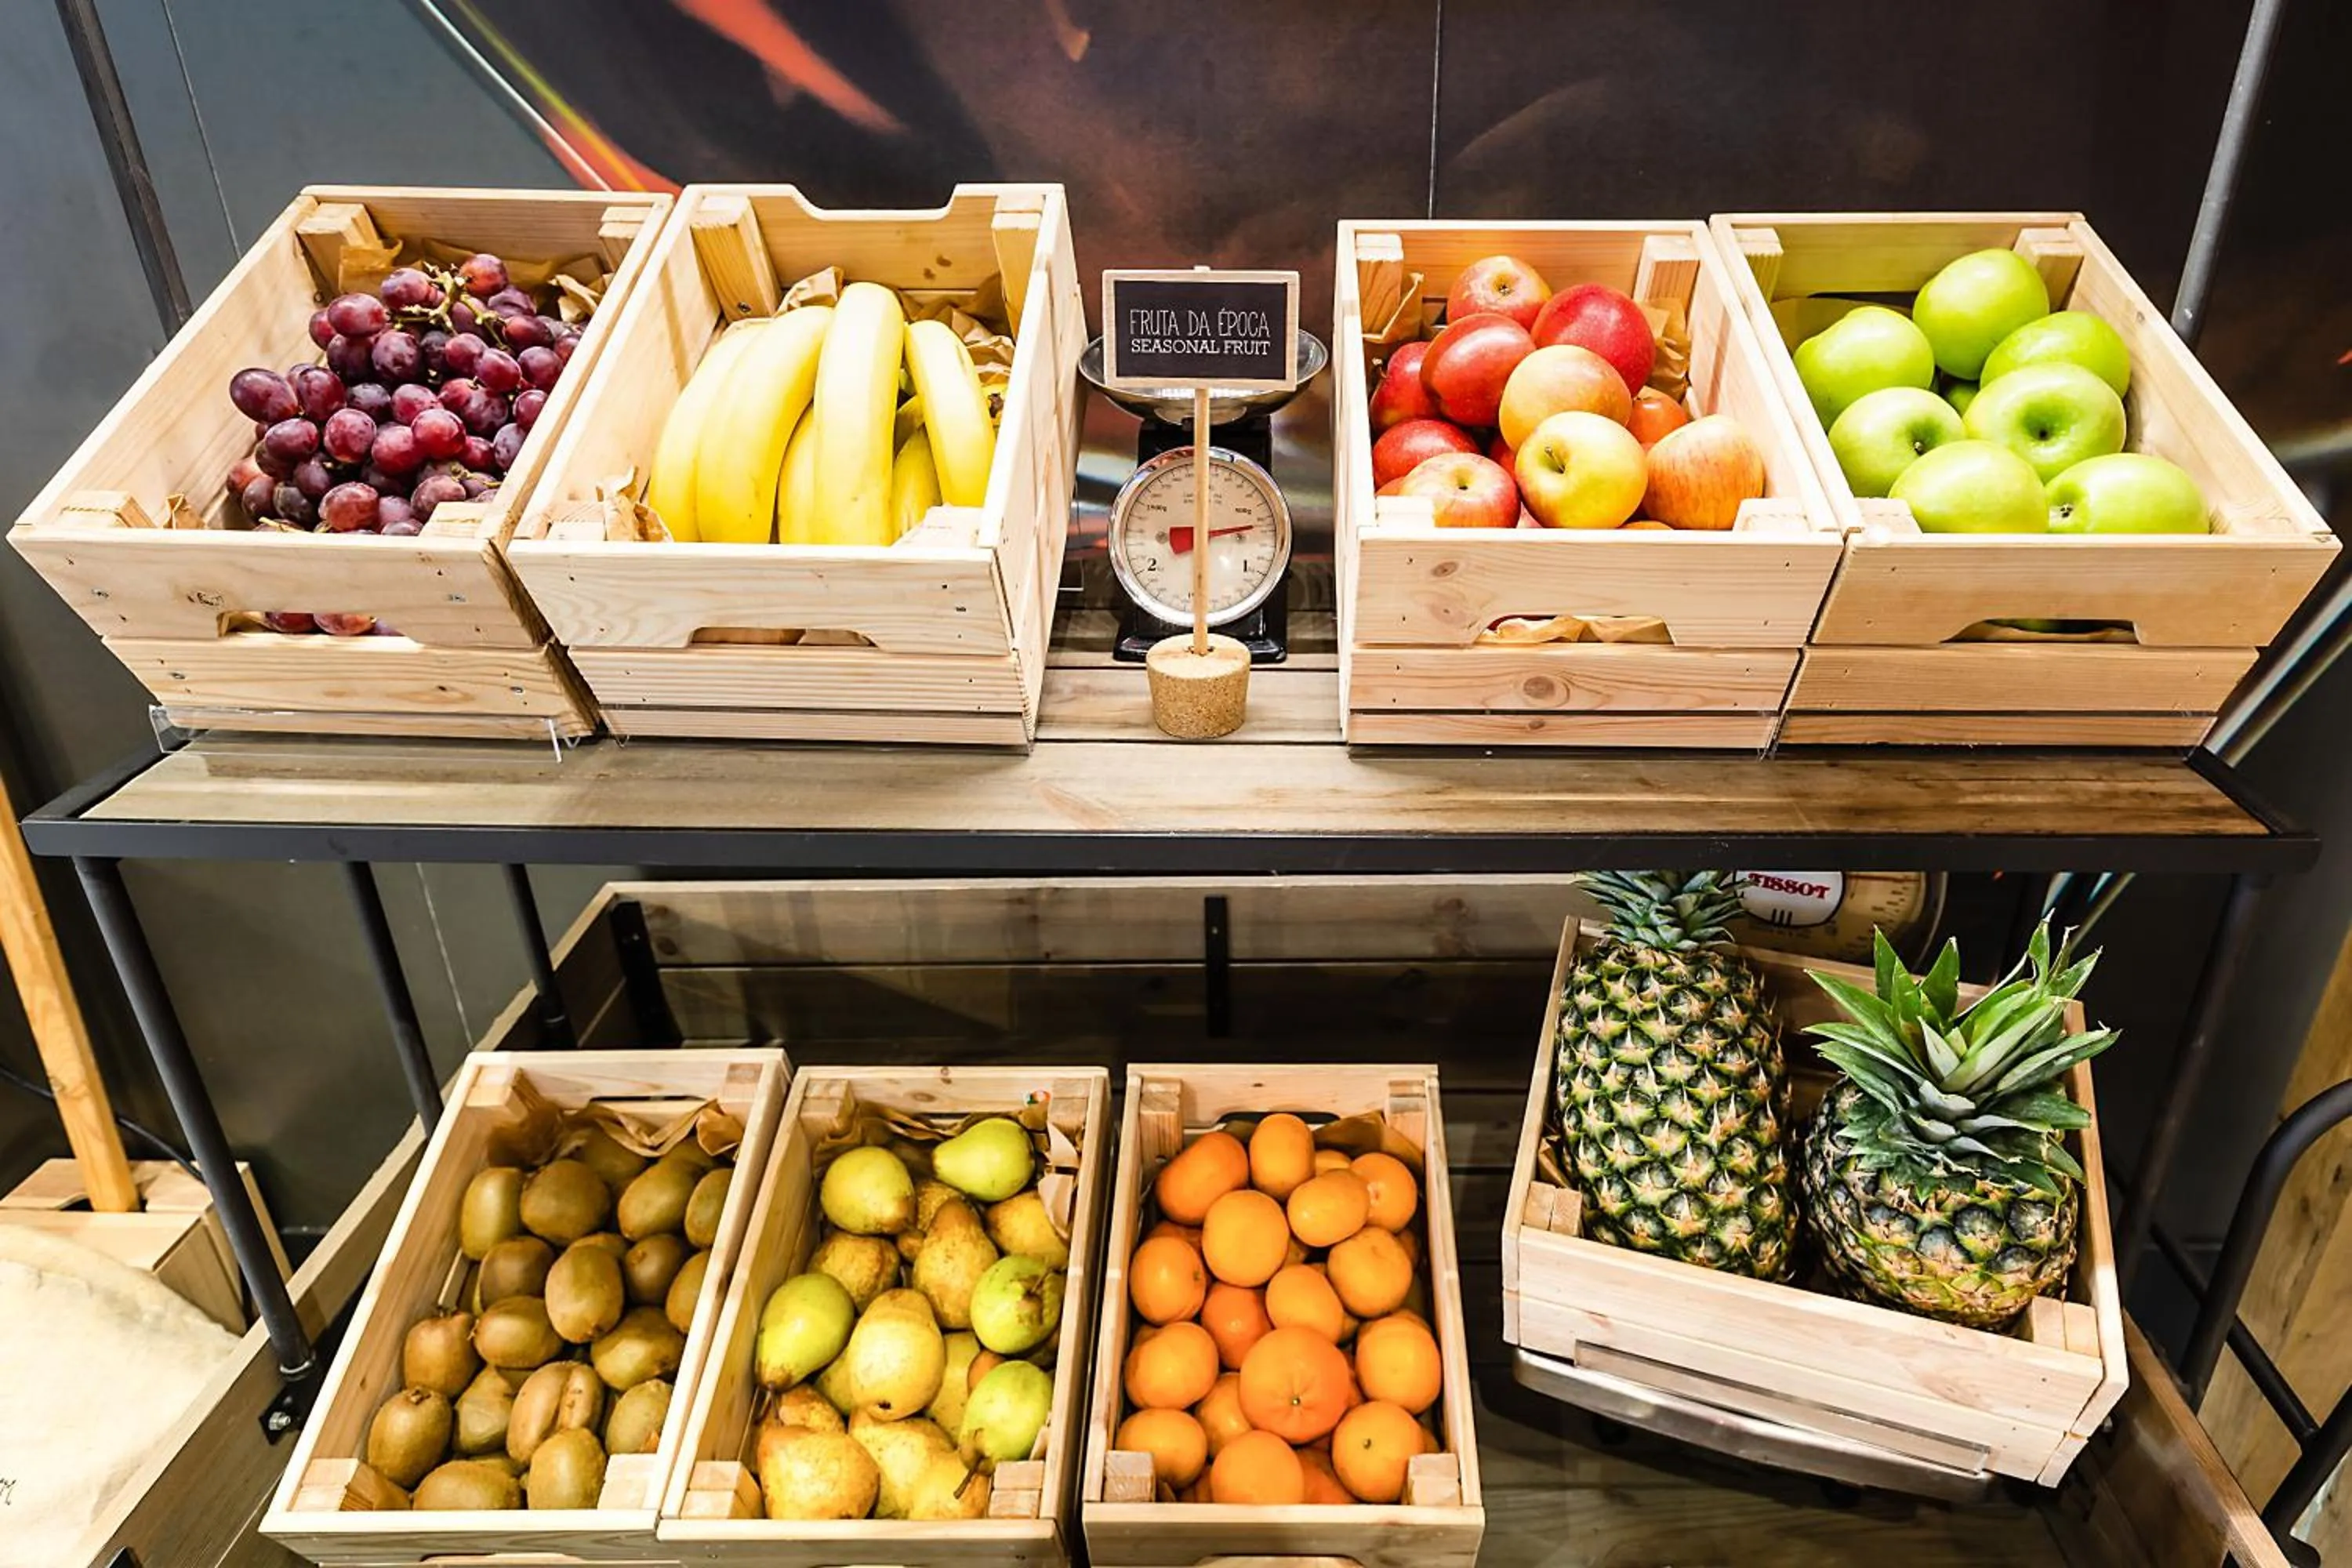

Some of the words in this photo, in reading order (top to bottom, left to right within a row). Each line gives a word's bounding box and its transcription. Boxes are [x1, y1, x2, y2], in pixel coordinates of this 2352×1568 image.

[1130, 309, 1180, 336] FRUTA
[1187, 310, 1211, 336] DA
[1218, 307, 1271, 338] ÉPOCA
[1131, 338, 1220, 354] SEASONAL
[1223, 339, 1271, 355] FRUIT
[1147, 557, 1157, 572] 2
[1748, 873, 1831, 899] TISSOT
